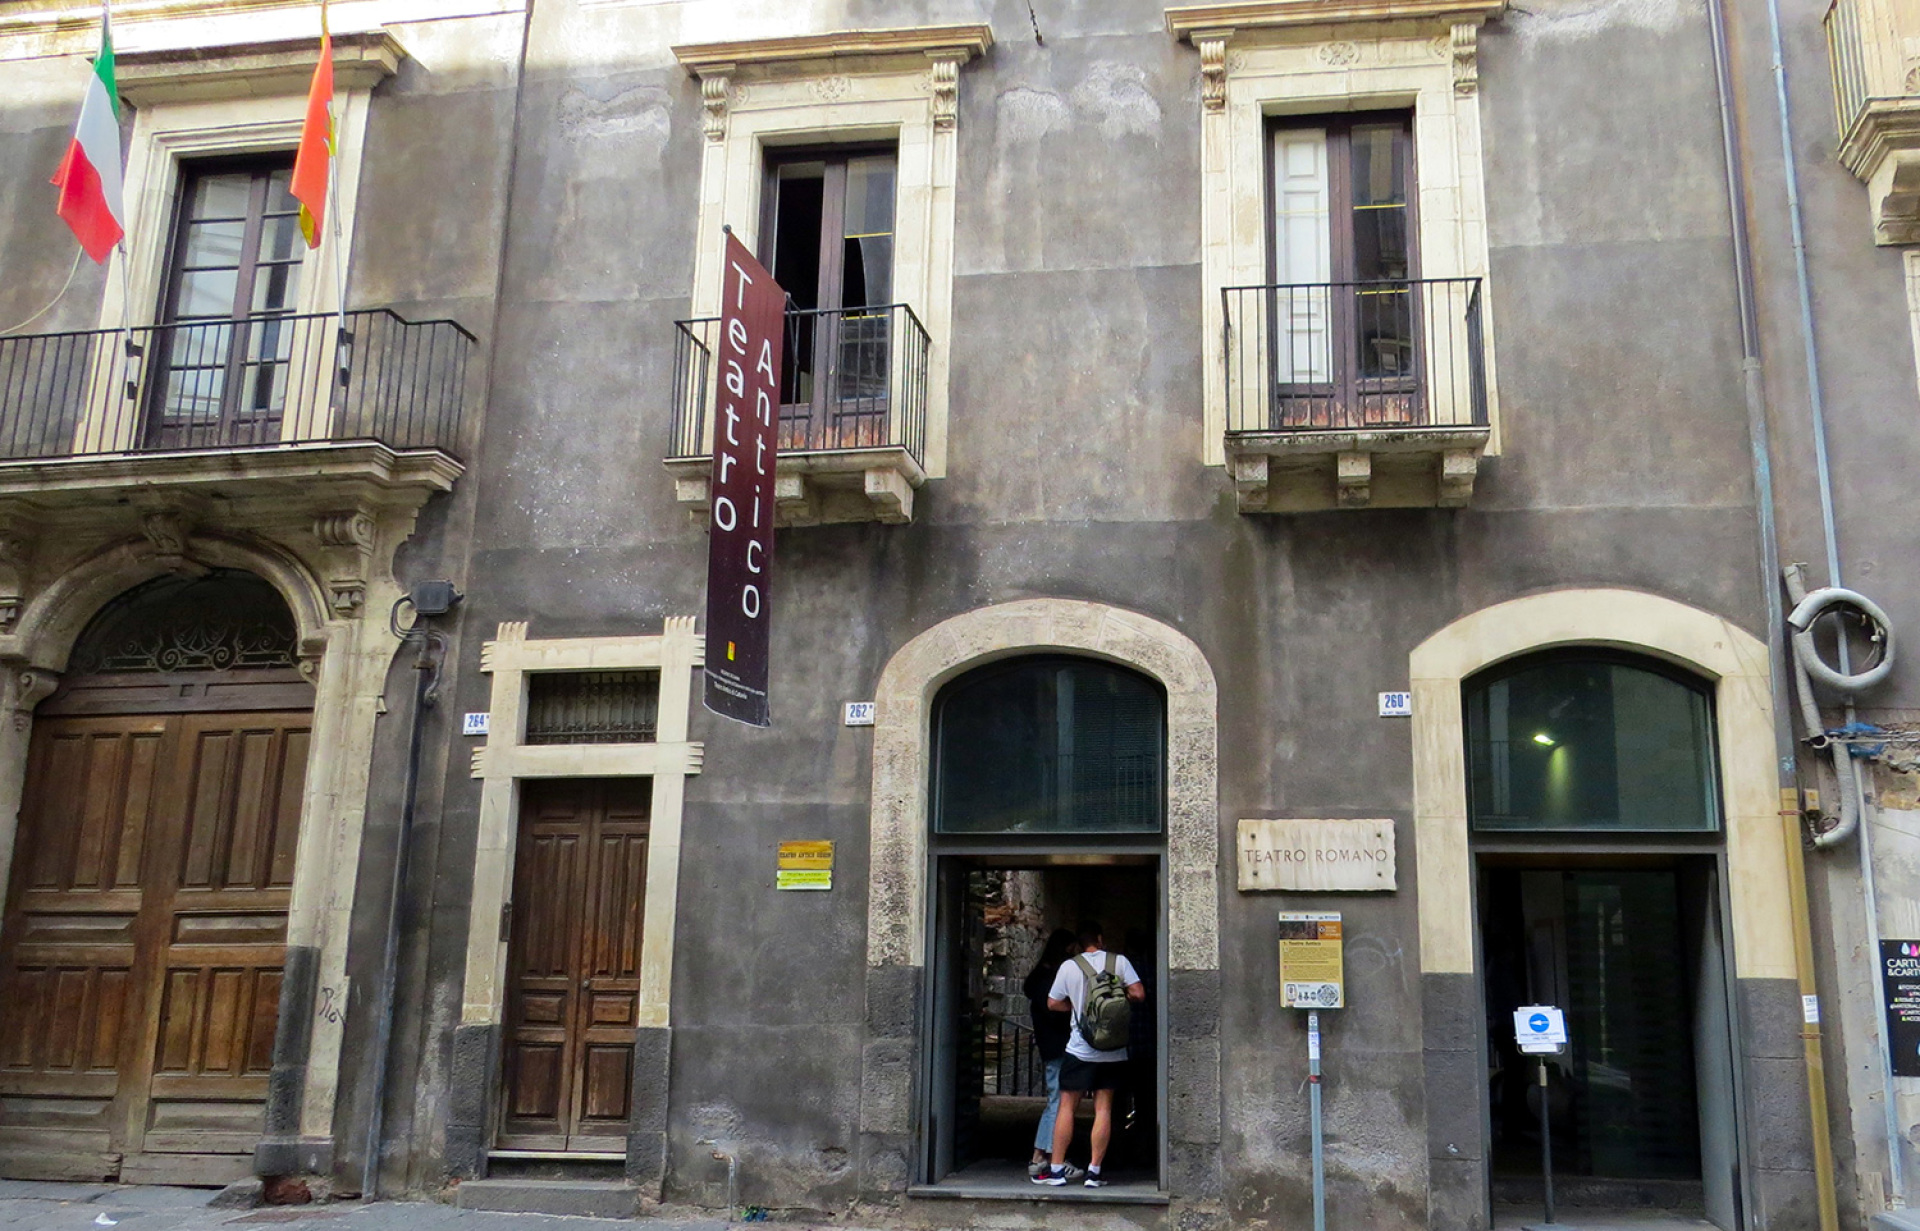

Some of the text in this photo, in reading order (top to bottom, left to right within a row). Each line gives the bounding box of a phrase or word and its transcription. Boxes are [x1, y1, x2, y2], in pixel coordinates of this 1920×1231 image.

[714, 260, 753, 532] Teatro
[742, 338, 776, 619] Antico
[1384, 694, 1404, 708] 260
[850, 704, 868, 718] 262
[468, 714, 485, 727] 264
[1244, 849, 1387, 862] TEATRO ROMANO
